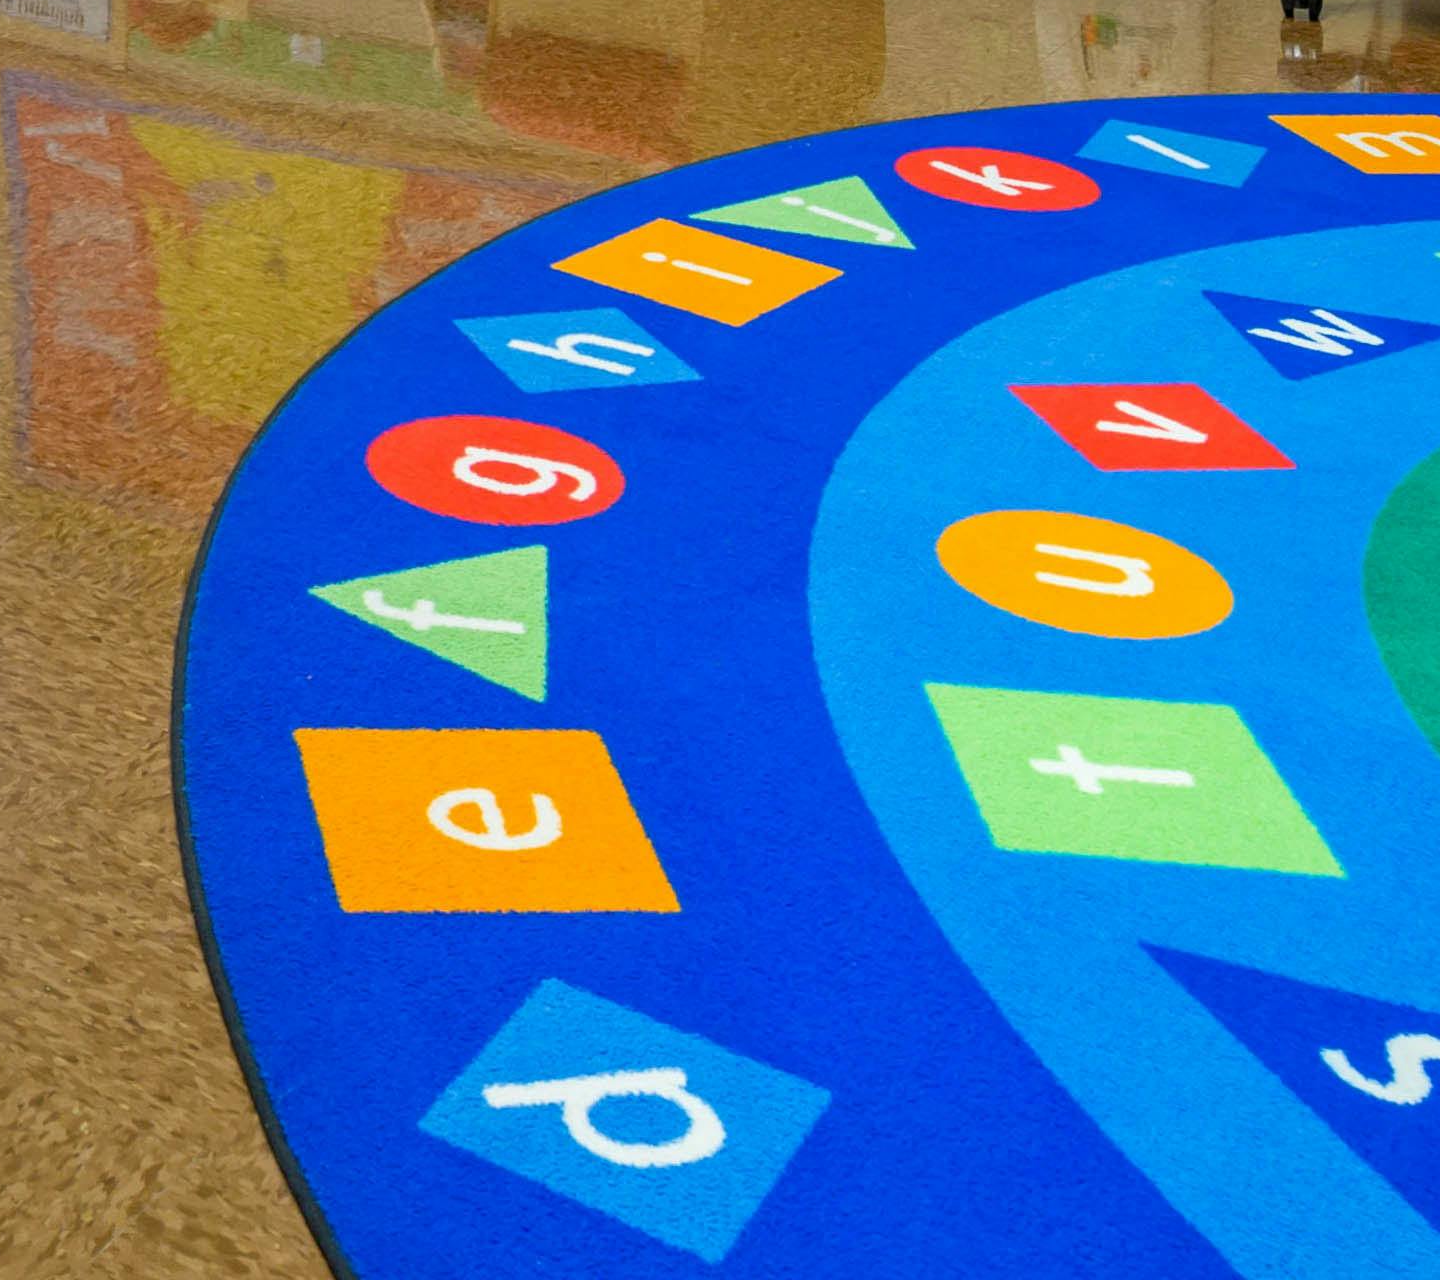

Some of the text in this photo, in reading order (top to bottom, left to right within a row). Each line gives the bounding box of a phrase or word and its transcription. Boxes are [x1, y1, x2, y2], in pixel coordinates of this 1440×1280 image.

[930, 160, 1053, 196] k
[775, 194, 904, 245] j
[642, 250, 752, 286] i
[508, 333, 655, 375] h
[1247, 309, 1384, 356] w
[1096, 400, 1208, 444] v
[453, 446, 597, 502] g
[1035, 543, 1154, 597] u
[360, 587, 529, 637] f
[1026, 741, 1200, 800] t
[427, 787, 562, 851] e
[483, 1068, 726, 1168] d
